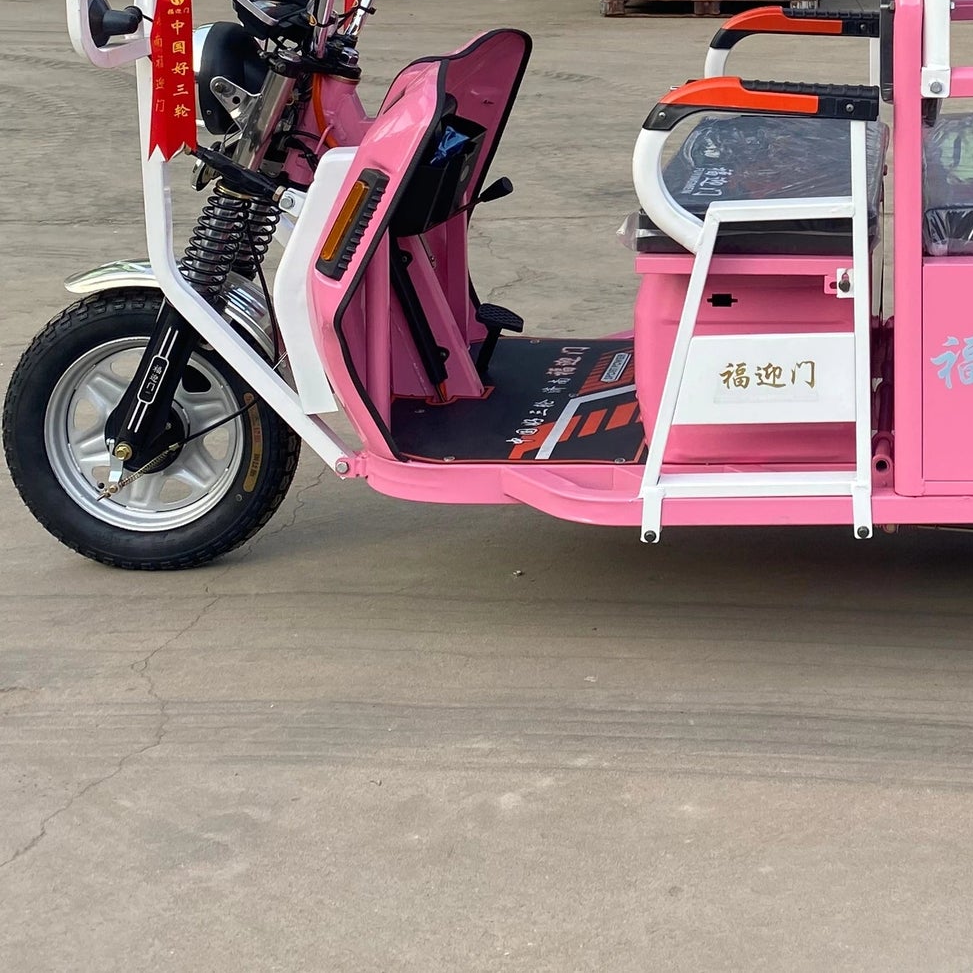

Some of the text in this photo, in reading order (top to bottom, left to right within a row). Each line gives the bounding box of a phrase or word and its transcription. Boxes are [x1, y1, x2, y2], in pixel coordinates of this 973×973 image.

[170, 20, 191, 118] 中国好三轮
[719, 360, 816, 391] 福迎门
